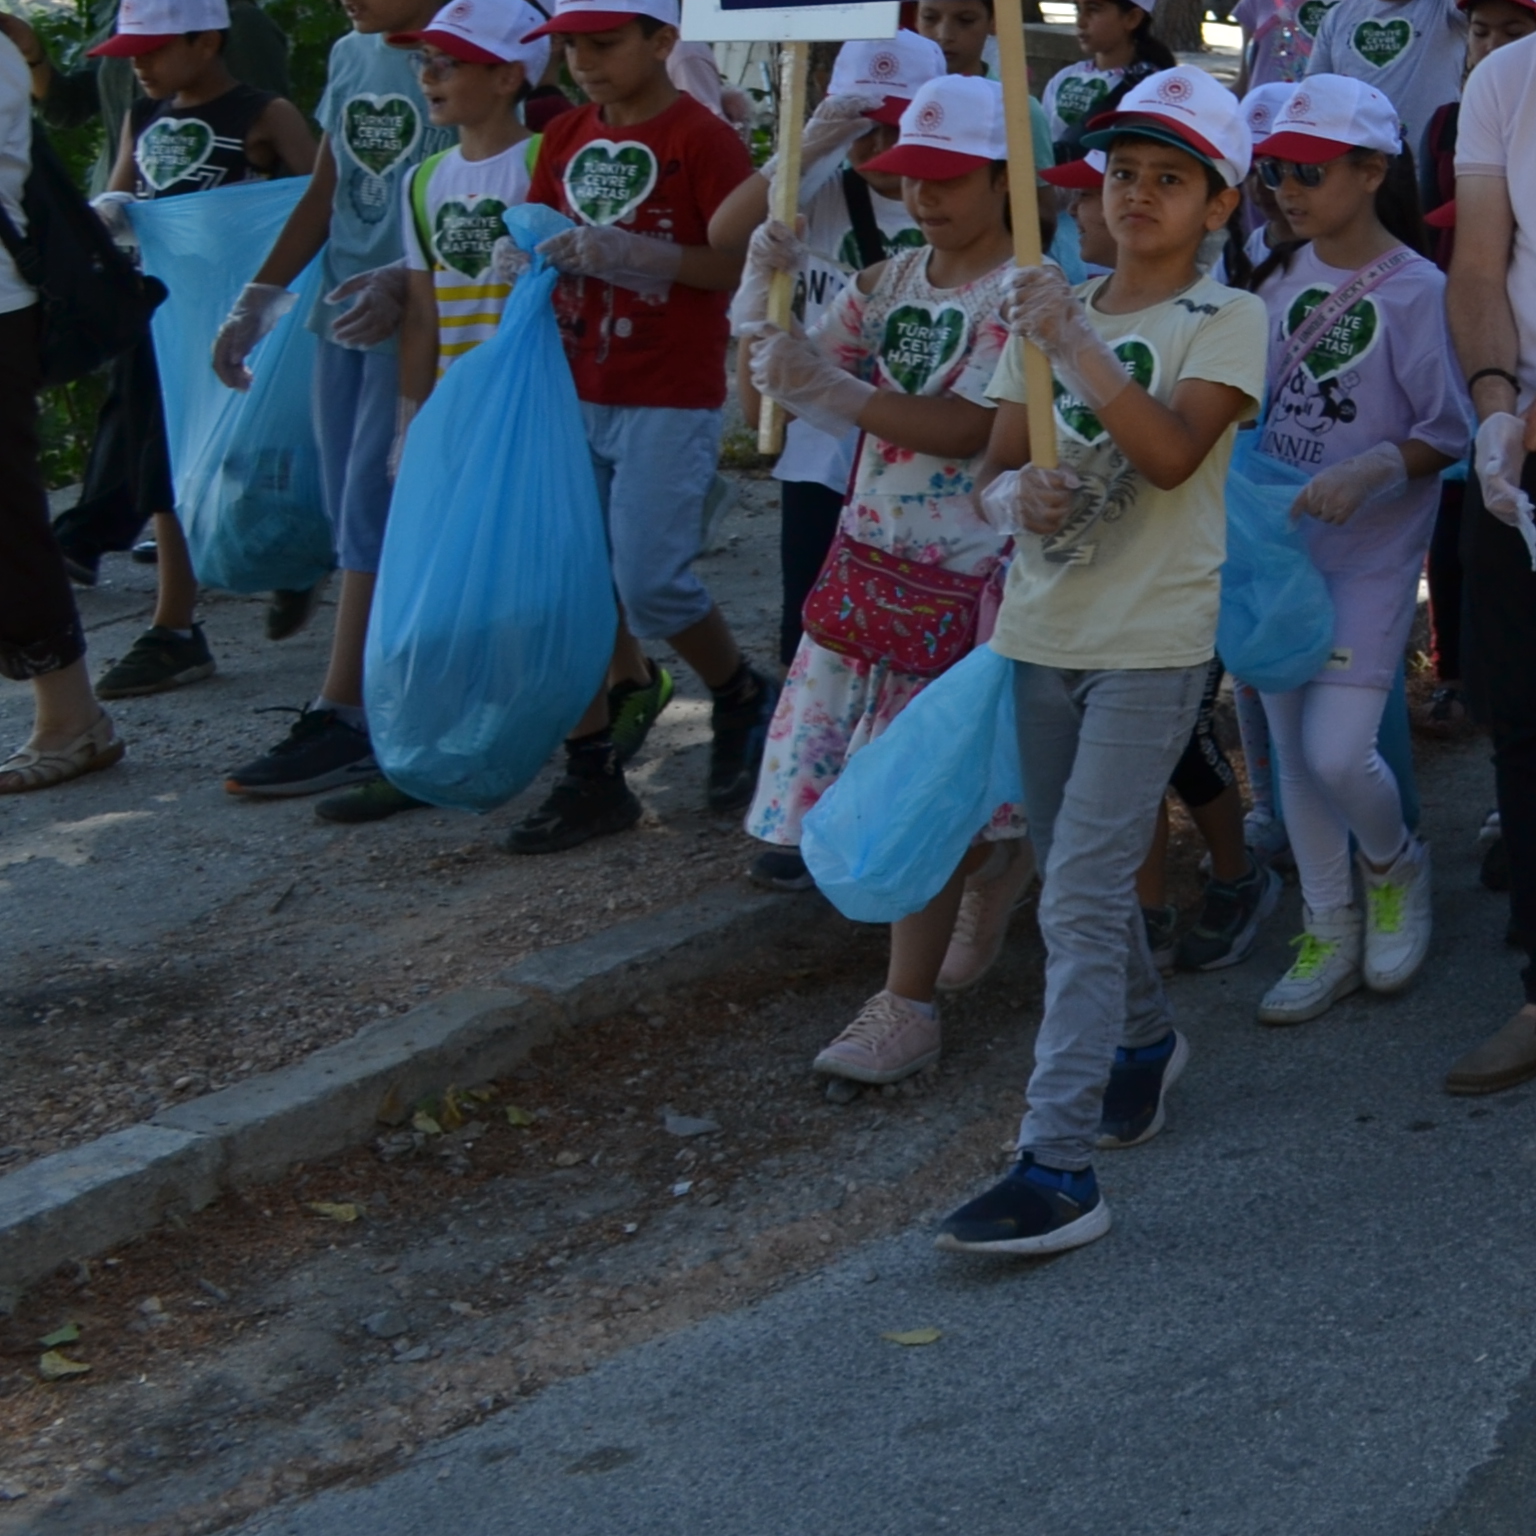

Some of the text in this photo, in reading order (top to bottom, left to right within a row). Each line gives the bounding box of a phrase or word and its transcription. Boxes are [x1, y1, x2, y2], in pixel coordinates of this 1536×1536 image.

[353, 113, 403, 126] TÜRKİYE
[352, 138, 402, 150] HAFTASI
[583, 159, 639, 176] TÜRKİYE
[575, 185, 630, 200] HAFTASI
[1335, 277, 1366, 308] LUCKY
